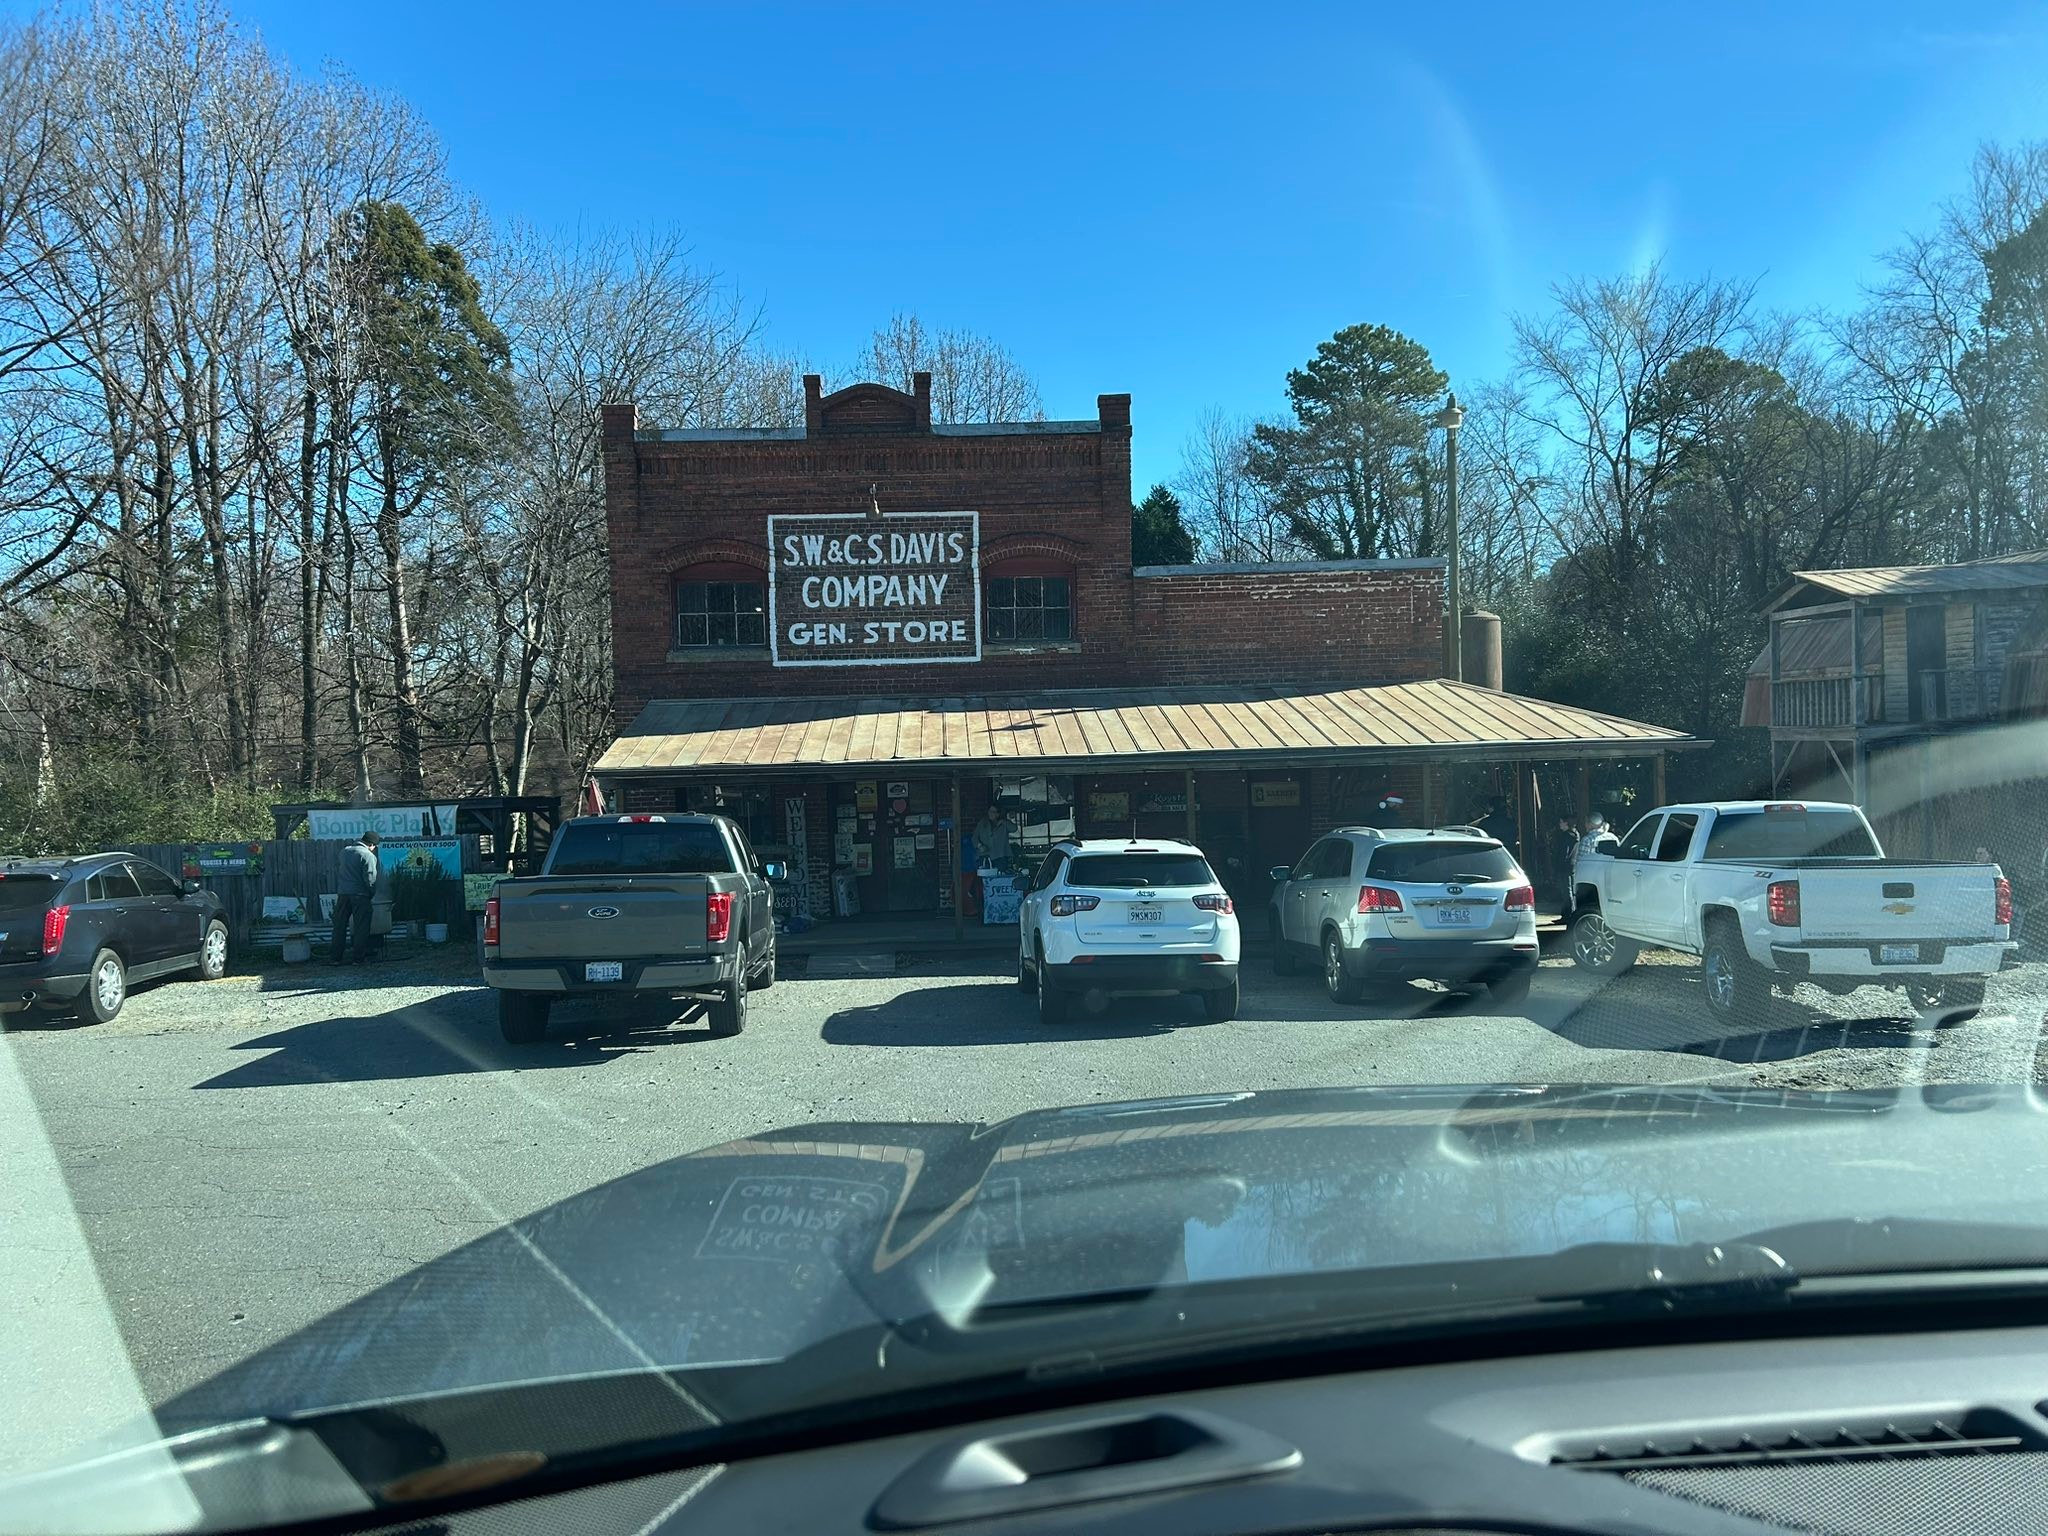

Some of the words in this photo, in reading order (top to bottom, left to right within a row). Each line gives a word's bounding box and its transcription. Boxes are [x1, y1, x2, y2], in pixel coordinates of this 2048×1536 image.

[802, 574, 949, 608] COMPANY
[788, 623, 854, 646] GEN.
[863, 620, 967, 644] STORE
[315, 813, 387, 835] Bonnie
[389, 813, 453, 833] Plas
[406, 841, 438, 849] WONDER
[774, 896, 797, 908] SEED
[1130, 911, 1162, 921] 9MSM307
